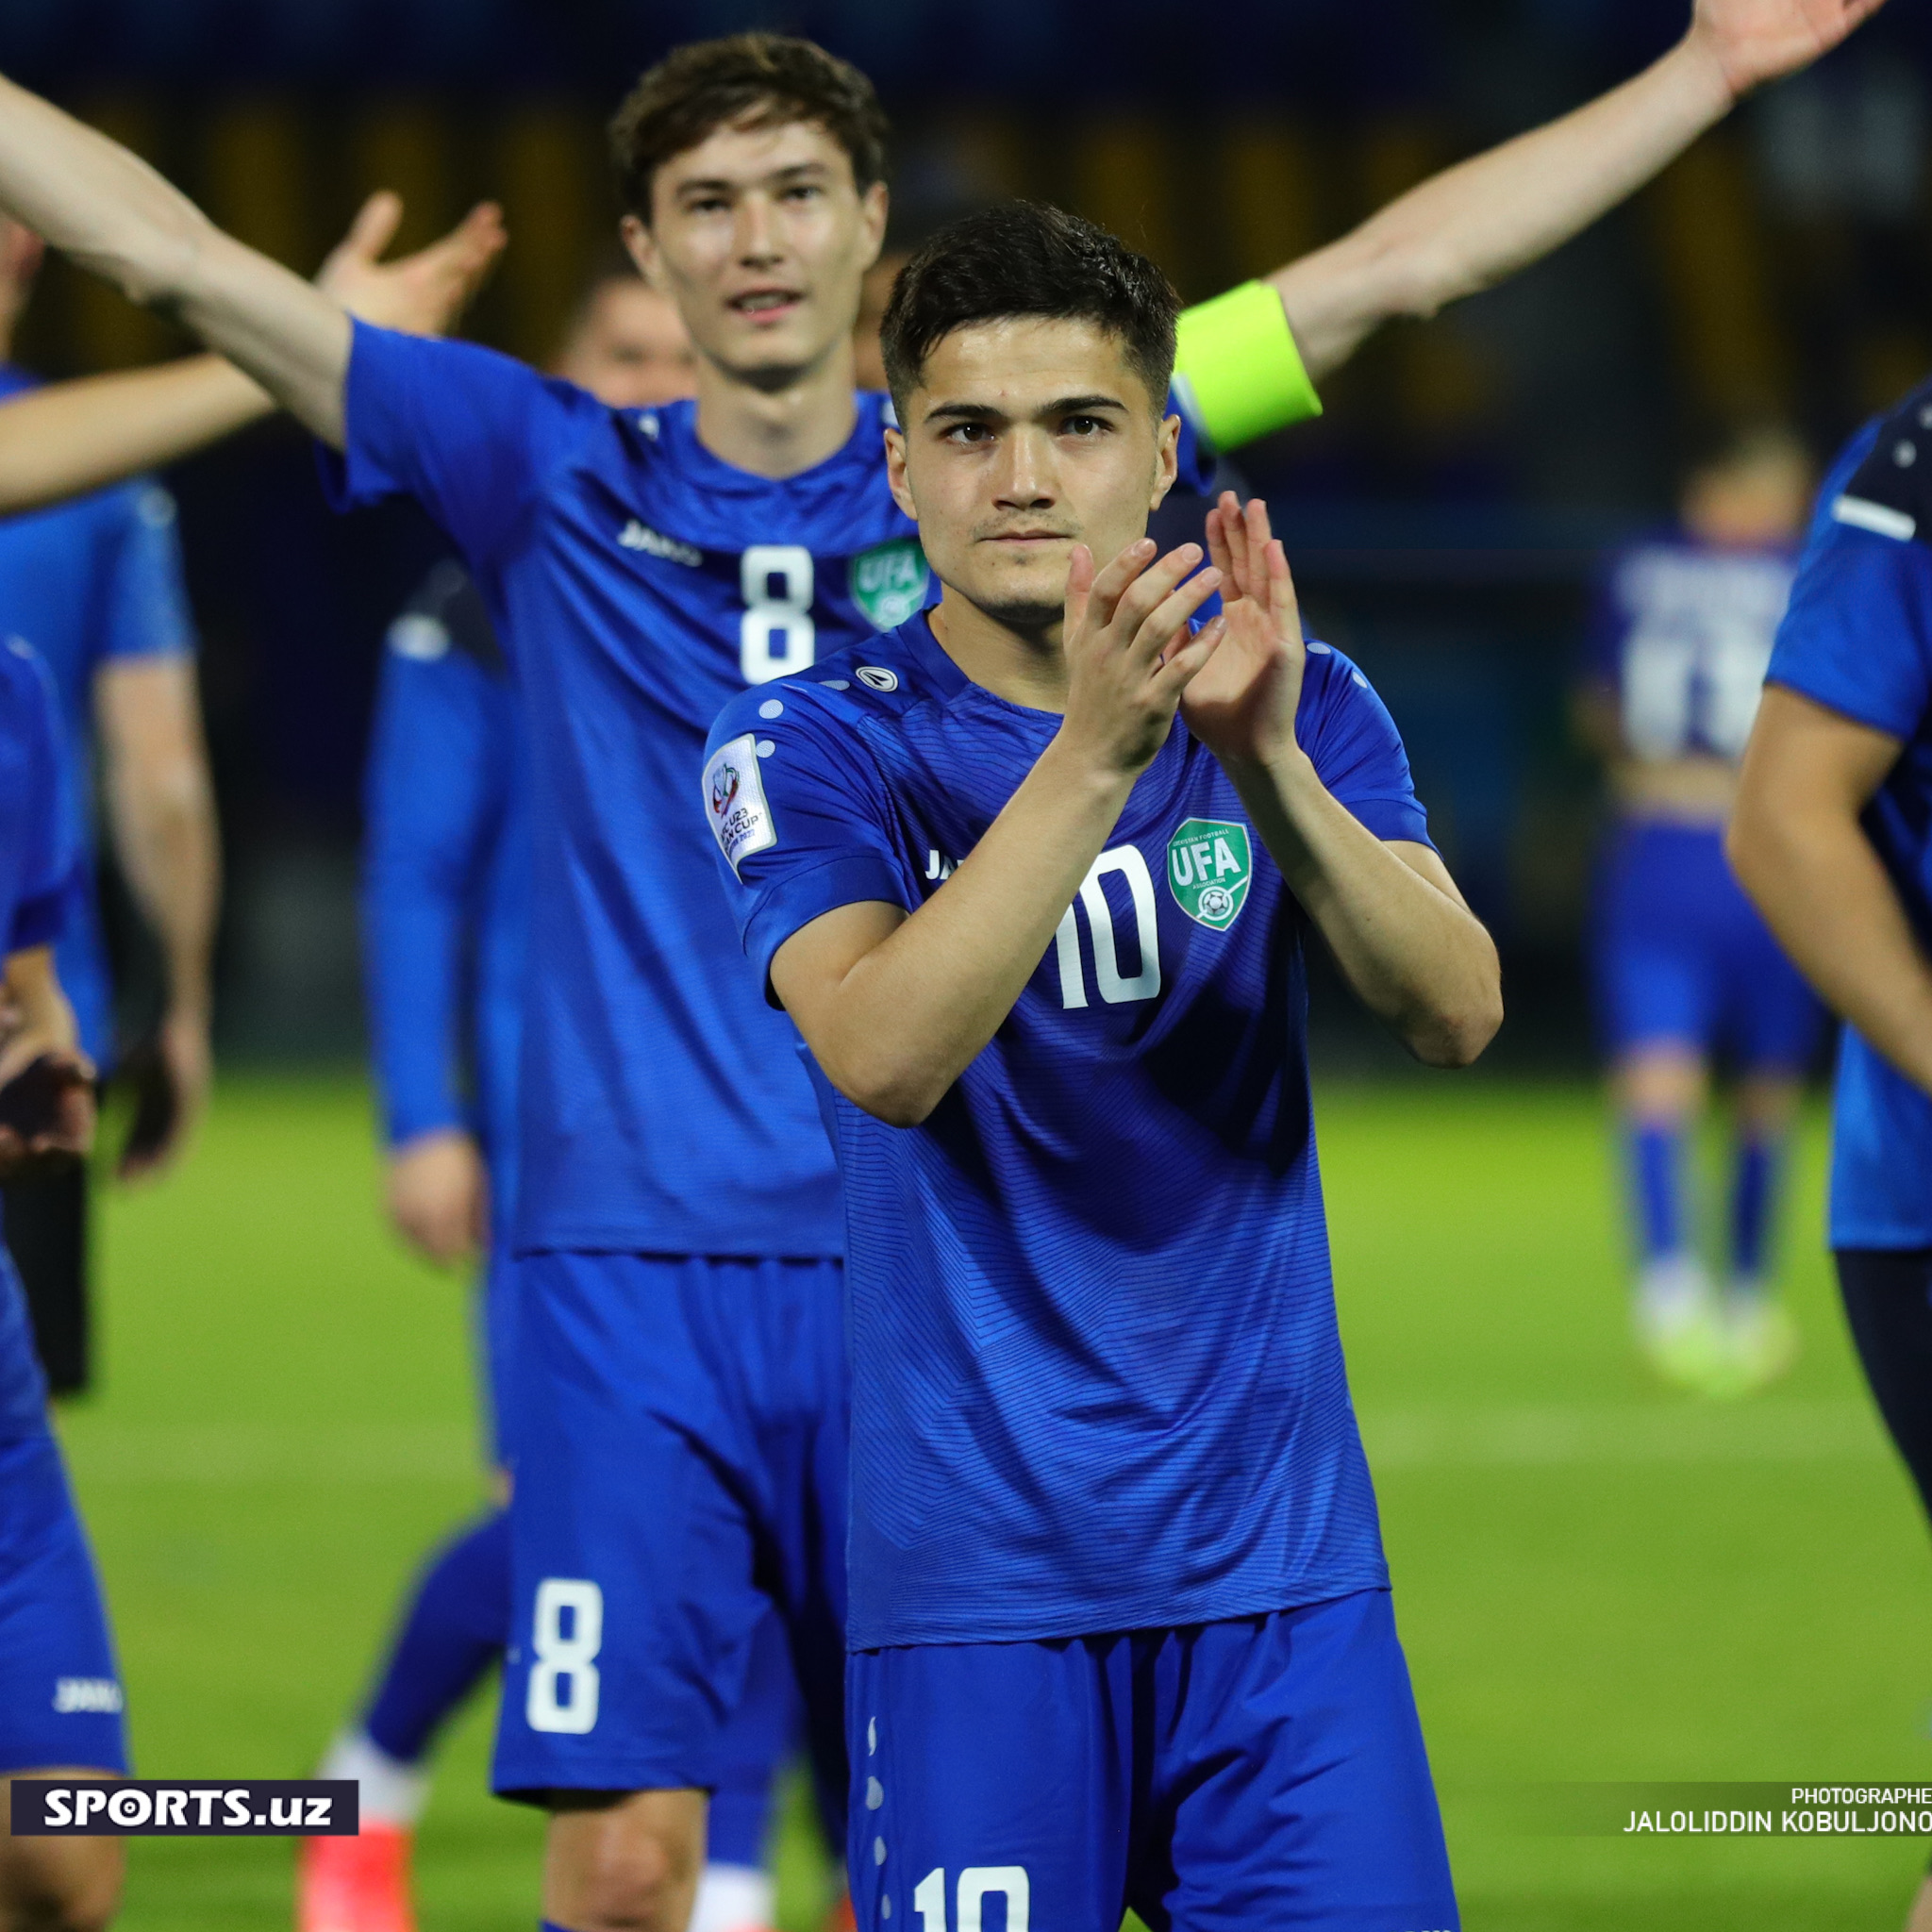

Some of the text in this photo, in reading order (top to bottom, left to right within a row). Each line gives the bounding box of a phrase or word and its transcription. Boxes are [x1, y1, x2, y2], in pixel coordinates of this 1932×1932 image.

[741, 545, 814, 685] 8
[729, 808, 748, 825] U23
[735, 815, 758, 834] CUP
[924, 850, 965, 880] JA
[1172, 837, 1241, 887] UFA
[1056, 844, 1160, 1009] 10
[525, 1576, 604, 1735] 8
